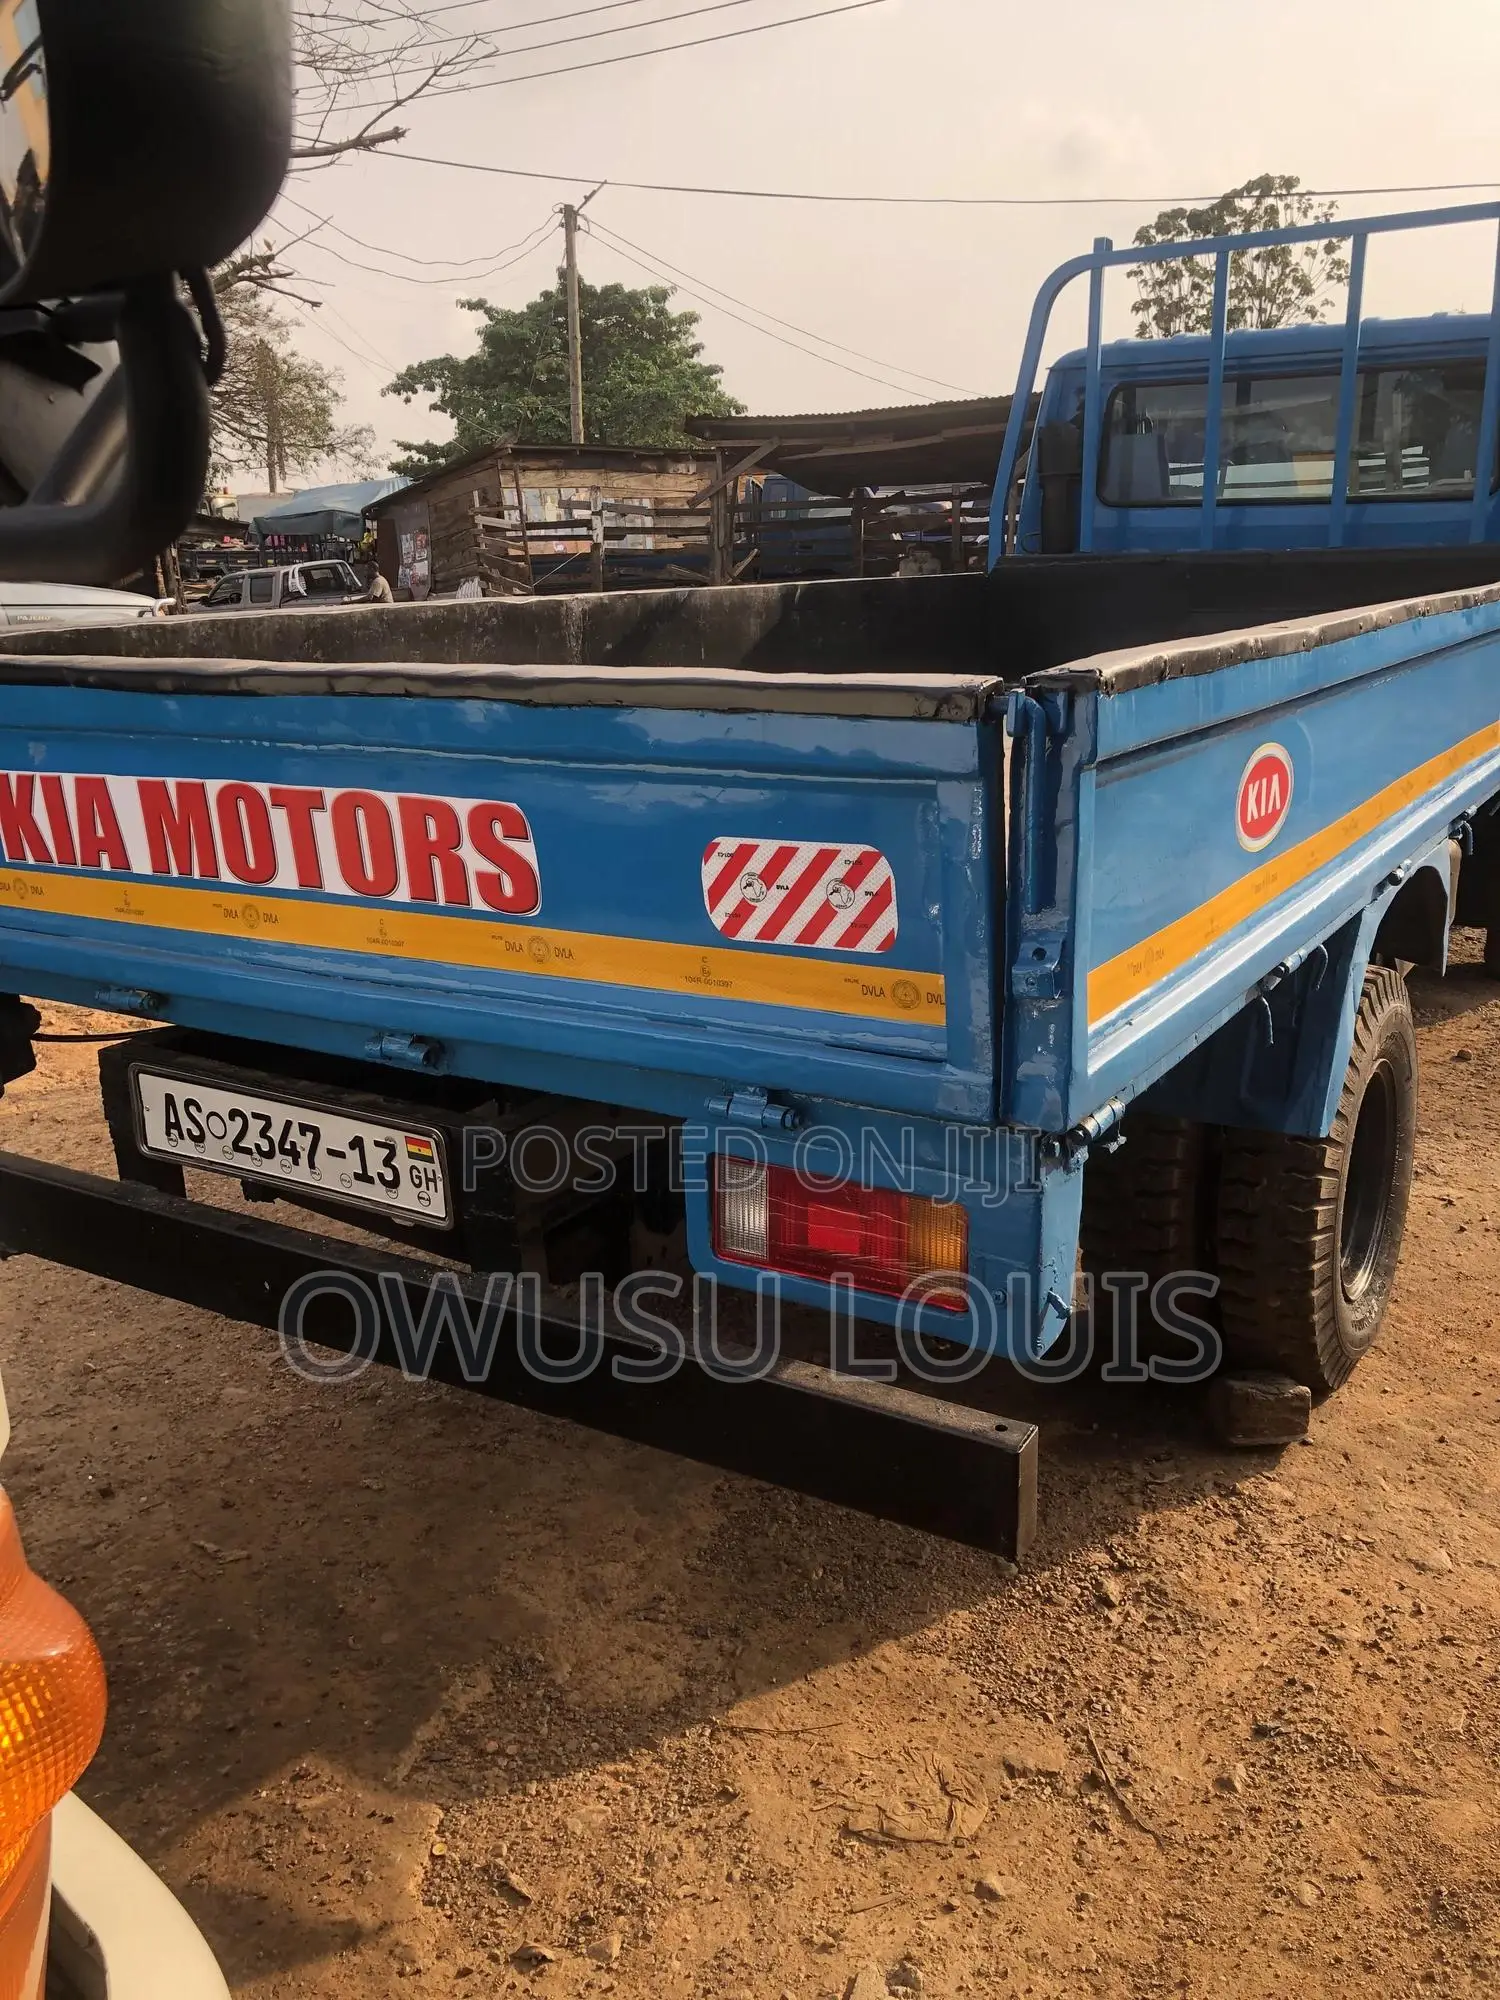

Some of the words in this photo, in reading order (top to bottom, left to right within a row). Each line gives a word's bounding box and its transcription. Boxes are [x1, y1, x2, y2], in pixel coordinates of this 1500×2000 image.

[1247, 772, 1281, 824] KIA
[0, 773, 132, 872] KIA
[137, 779, 540, 916] MOTORS
[504, 940, 523, 952] DVLA
[554, 946, 574, 960] DVLA
[861, 984, 886, 997] DVLA
[164, 1092, 206, 1144] AS
[228, 1108, 401, 1190] 2347-13
[409, 1164, 439, 1194] GH
